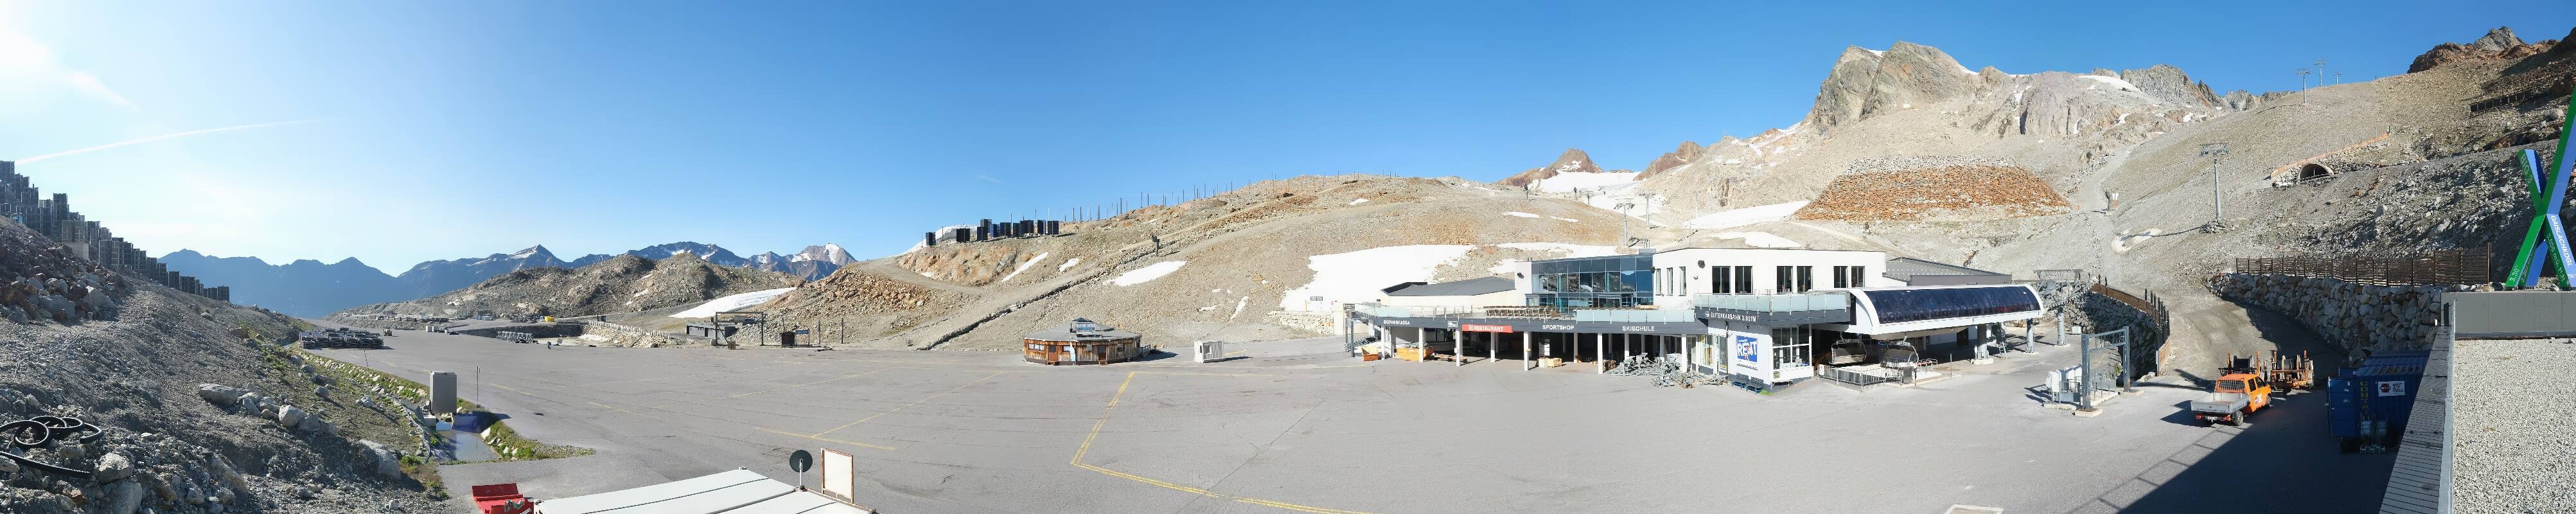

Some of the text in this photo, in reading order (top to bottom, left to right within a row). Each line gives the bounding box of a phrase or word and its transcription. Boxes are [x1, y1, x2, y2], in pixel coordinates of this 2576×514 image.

[2520, 154, 2530, 175] BIG
[2551, 215, 2572, 267] GAISLACHKOGL
[1711, 312, 1740, 321] SEITERKARBAHN
[1737, 341, 1757, 356] RENT
